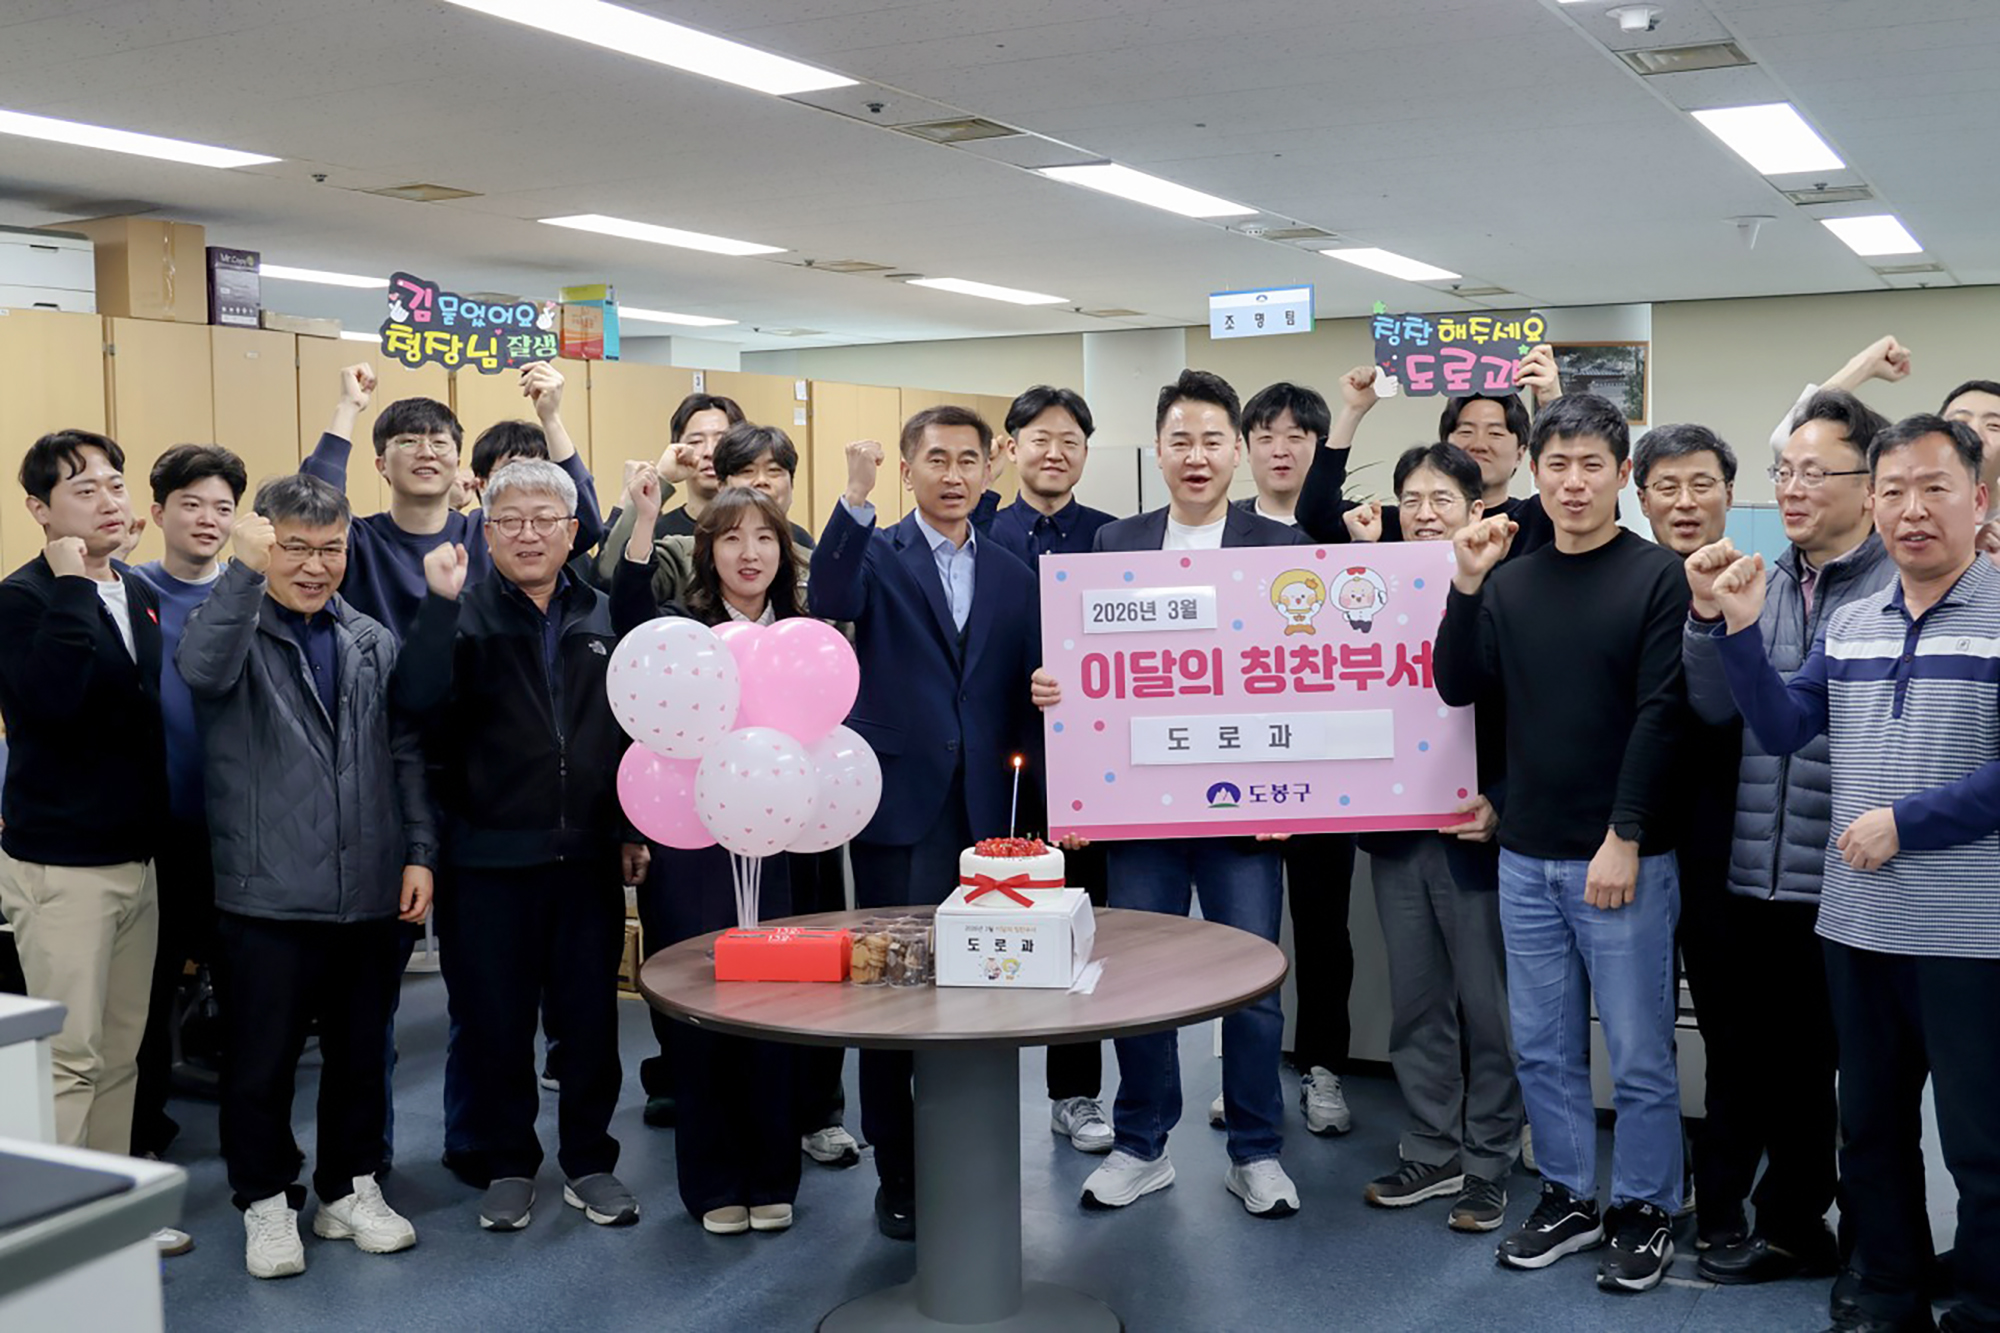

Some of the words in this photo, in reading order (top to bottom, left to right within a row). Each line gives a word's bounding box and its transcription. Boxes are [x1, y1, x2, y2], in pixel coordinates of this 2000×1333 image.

[397, 279, 432, 322] 김
[1225, 315, 1235, 330] 조
[1254, 313, 1265, 328] 명
[1285, 310, 1295, 326] 팀
[1373, 316, 1433, 346] 칭찬
[1437, 316, 1544, 345] 해주세요
[385, 323, 498, 369] 청장님
[506, 334, 558, 358] 잘생
[1406, 347, 1520, 391] 도로과
[1093, 600, 1157, 622] 2026년
[1168, 599, 1198, 620] 3월
[1081, 647, 1224, 699] 이달의
[1240, 640, 1434, 695] 칭찬부서
[1168, 728, 1190, 750] 도
[1218, 726, 1241, 749] 로
[1269, 724, 1292, 749] 과
[1249, 783, 1311, 804] 도봉구
[967, 938, 980, 951] 도
[994, 938, 1007, 952] 로
[1021, 939, 1034, 953] 과
